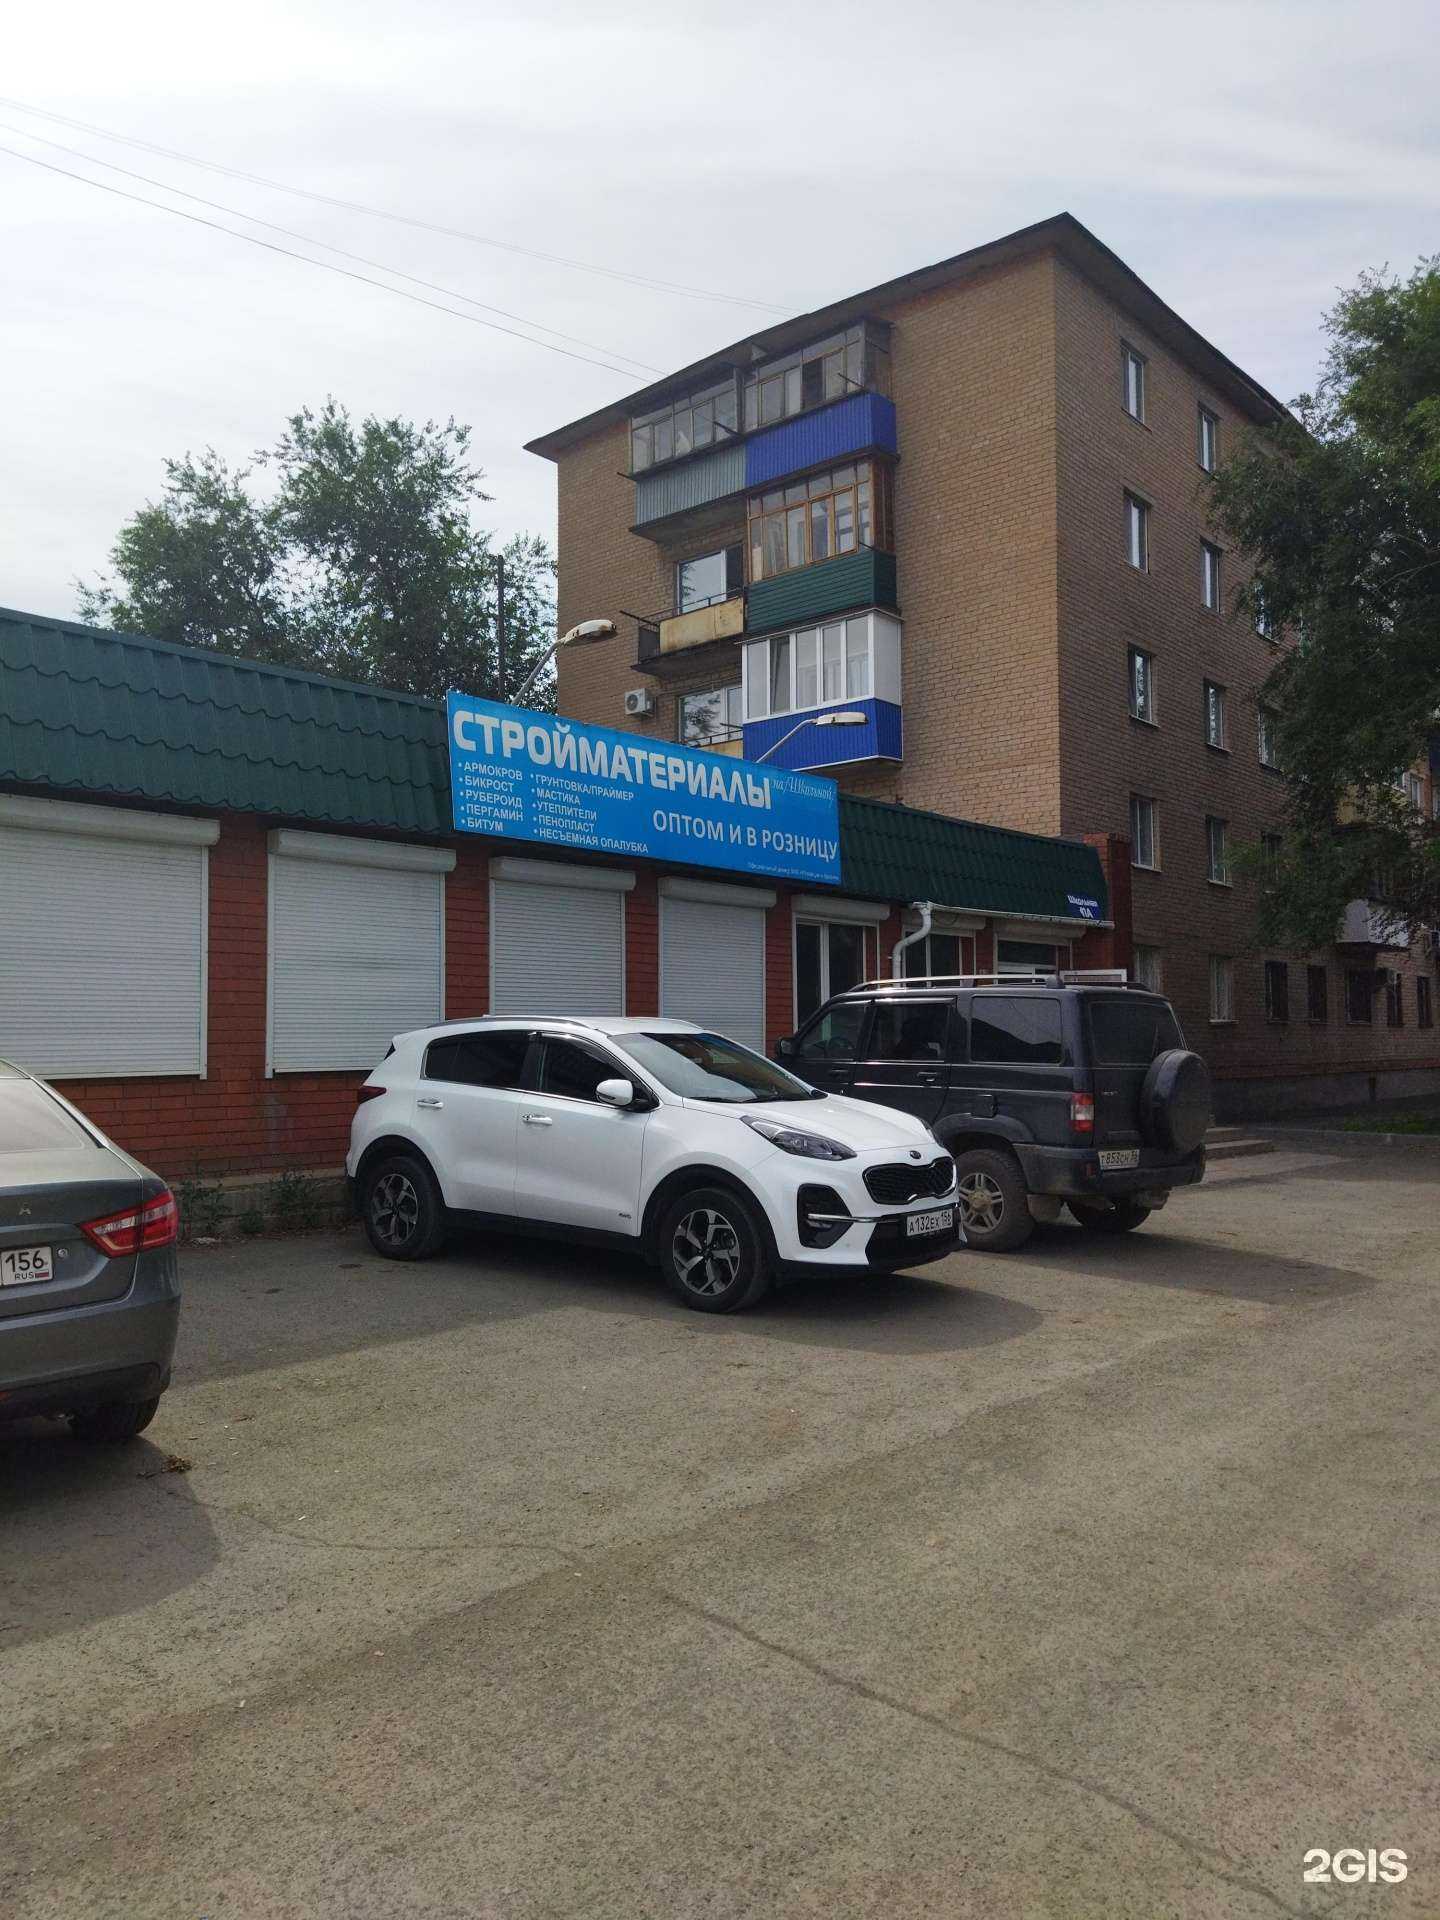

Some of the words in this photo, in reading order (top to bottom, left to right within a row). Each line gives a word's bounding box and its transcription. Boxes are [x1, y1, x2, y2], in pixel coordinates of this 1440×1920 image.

[453, 710, 771, 810] СТРОЙМАТЕРИАЛЫ
[464, 761, 523, 781] АРМОКРОВ
[465, 775, 515, 793] БИКРОСТ
[535, 774, 635, 801] ГРУНТОВКА/ПРАЙМЕР
[465, 789, 523, 810] РУБЕРОИД
[536, 787, 581, 805] МАСТИКА
[466, 803, 524, 822] ПЕРГАМИН
[537, 801, 597, 821] УТЕПЛИТЕЛИ
[467, 817, 504, 832] БИТУМ
[538, 815, 595, 833] ПЕНОПЛАСТ
[539, 827, 598, 846] НЕСЪЕМНАЯ
[600, 837, 649, 853] ОПАЛУБКА
[652, 810, 724, 842] ОПТОМ
[729, 824, 742, 845] И
[747, 827, 757, 847] В
[762, 829, 838, 863] РОЗНИЦУ
[5, 1250, 45, 1272] 156
[14, 1271, 34, 1280] RUS
